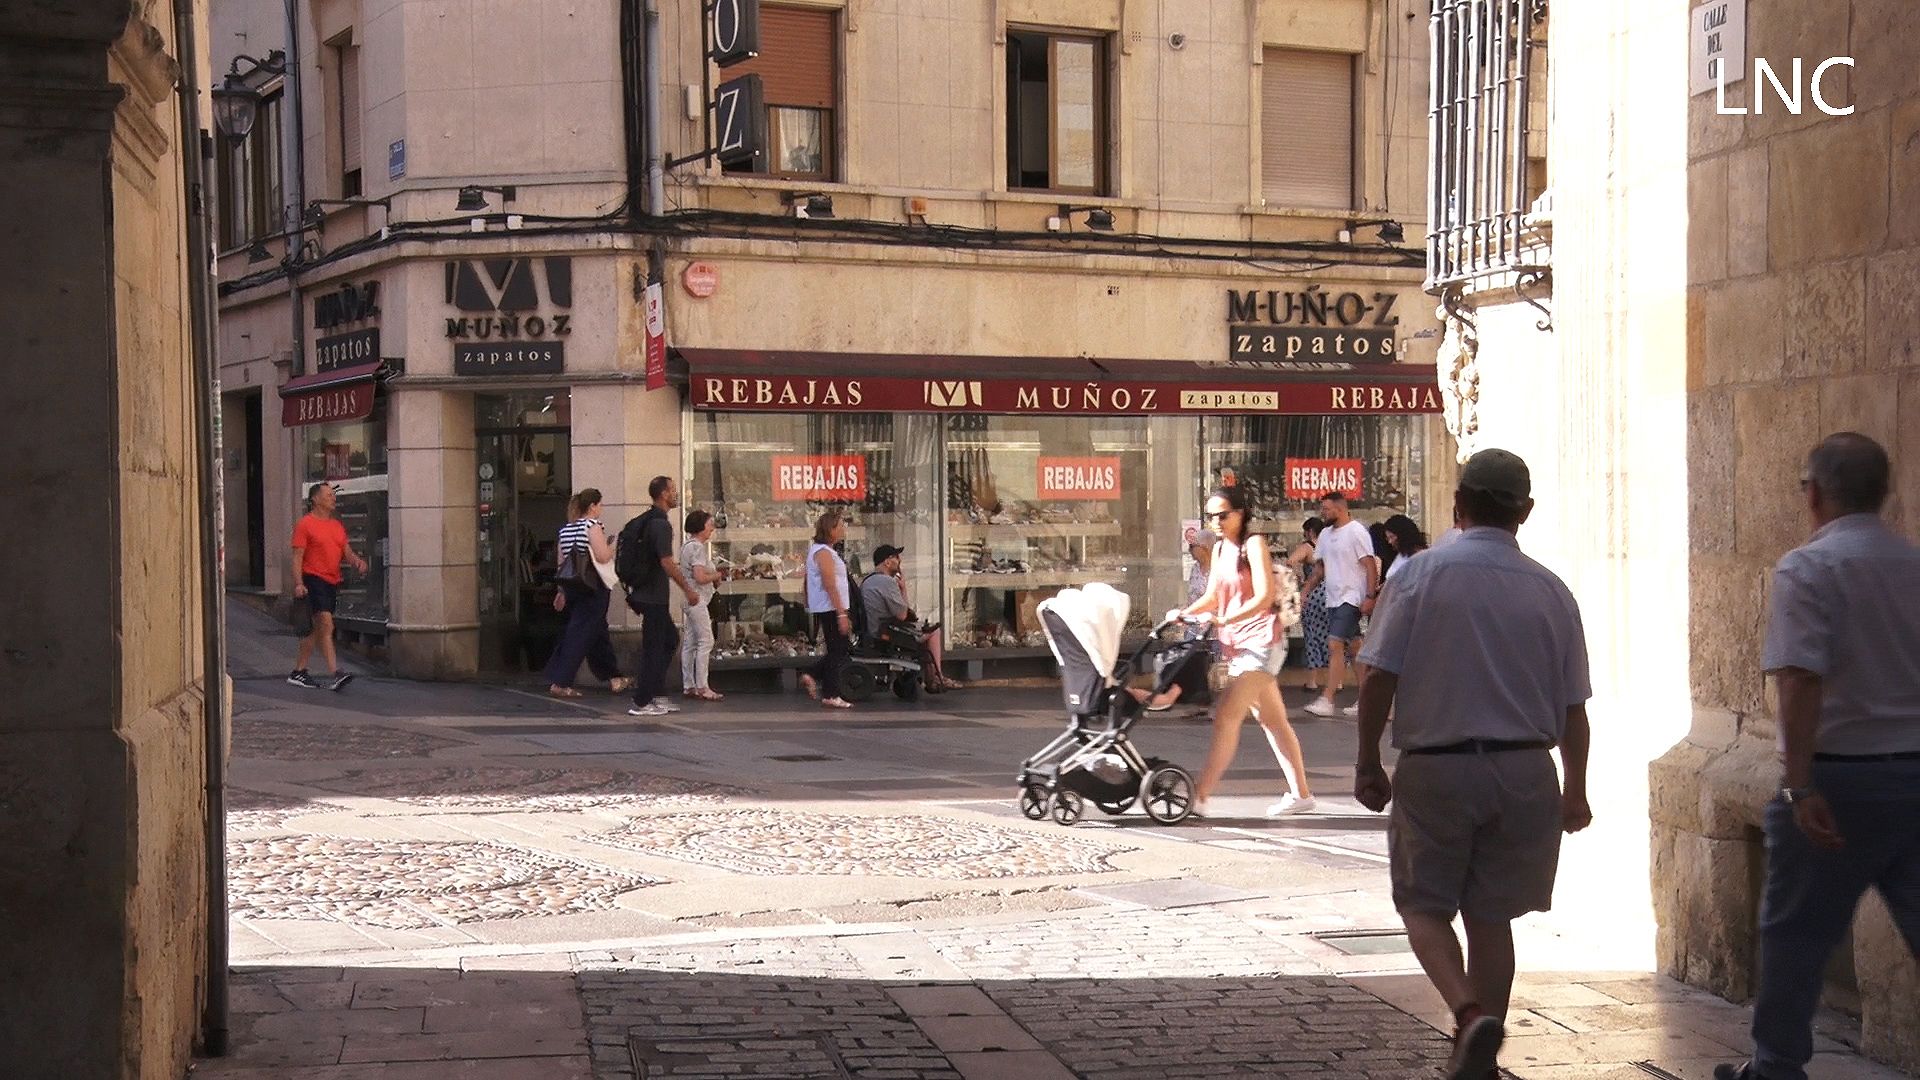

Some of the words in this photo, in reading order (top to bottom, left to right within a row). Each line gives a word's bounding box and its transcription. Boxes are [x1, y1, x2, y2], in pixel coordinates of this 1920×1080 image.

[1704, 3, 1728, 32] CALLE
[1707, 32, 1722, 56] DEL
[317, 335, 371, 368] zapatos
[464, 350, 552, 365] zapatos
[1237, 333, 1393, 359] zapatos
[299, 390, 356, 421] REBAJAS
[705, 378, 862, 406] REBAJAS
[1016, 382, 1158, 410] MUÑOZ
[1187, 391, 1273, 407] zapatos
[1331, 387, 1443, 409] REBAJA
[780, 464, 858, 491] REBAJAS
[1044, 465, 1115, 491] REBAJAS
[1291, 467, 1357, 491] REBAJAS
